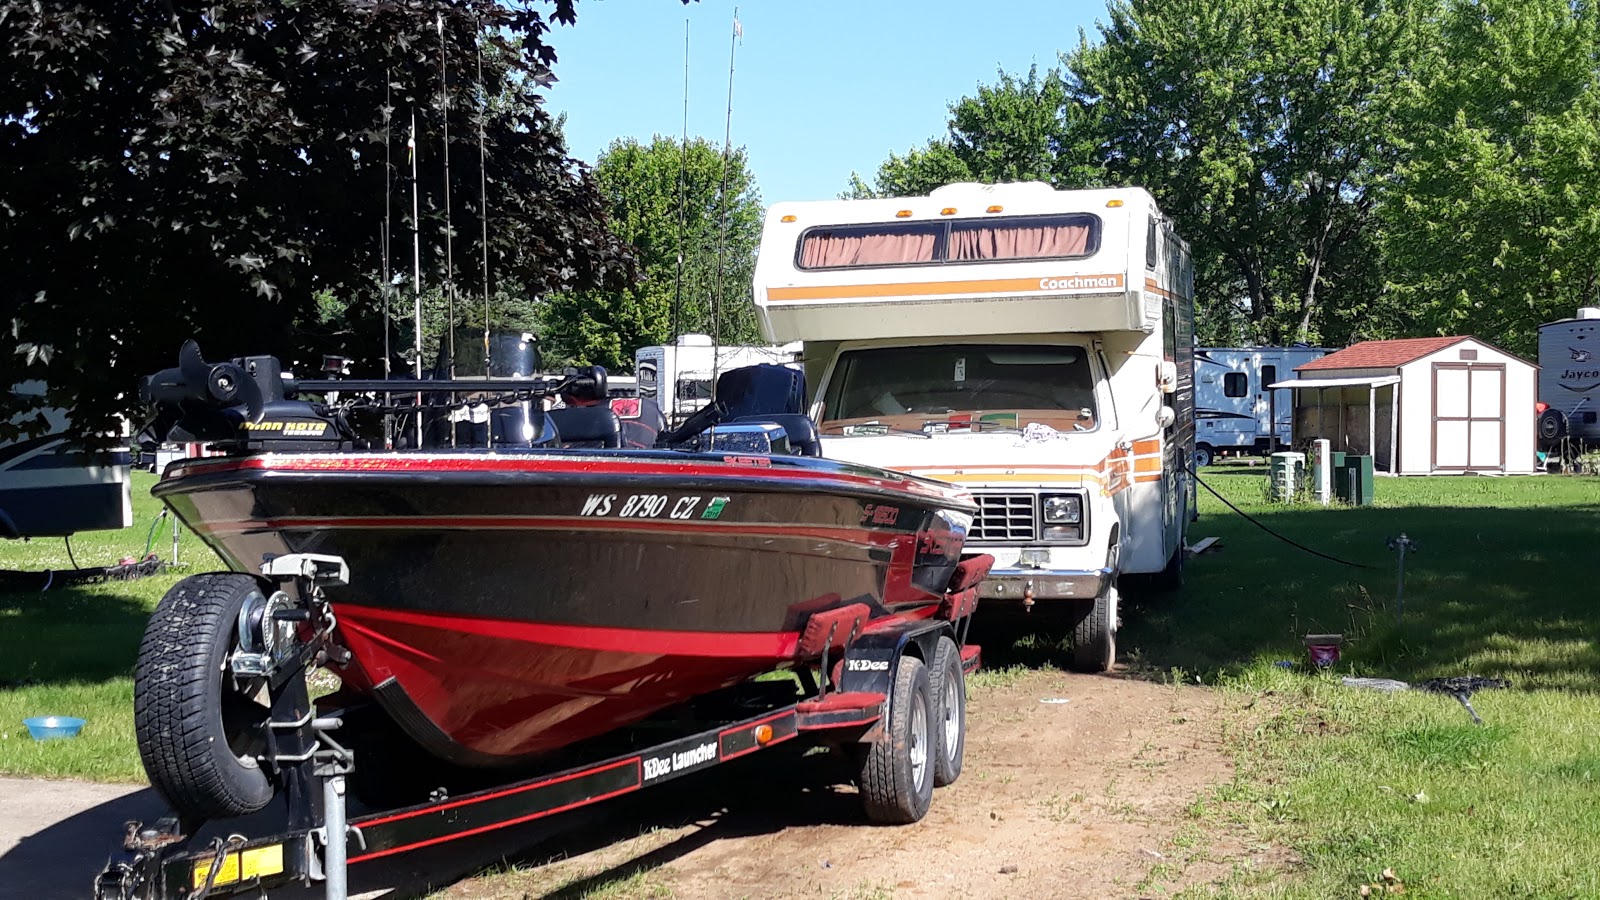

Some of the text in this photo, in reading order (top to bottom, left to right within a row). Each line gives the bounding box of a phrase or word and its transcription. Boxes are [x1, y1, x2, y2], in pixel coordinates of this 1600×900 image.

[1040, 277, 1117, 289] Coachmen
[1561, 370, 1599, 380] Jayco
[284, 422, 328, 431] KOTA
[580, 493, 702, 519] WS 8790 CZ
[672, 741, 718, 771] Launcher
